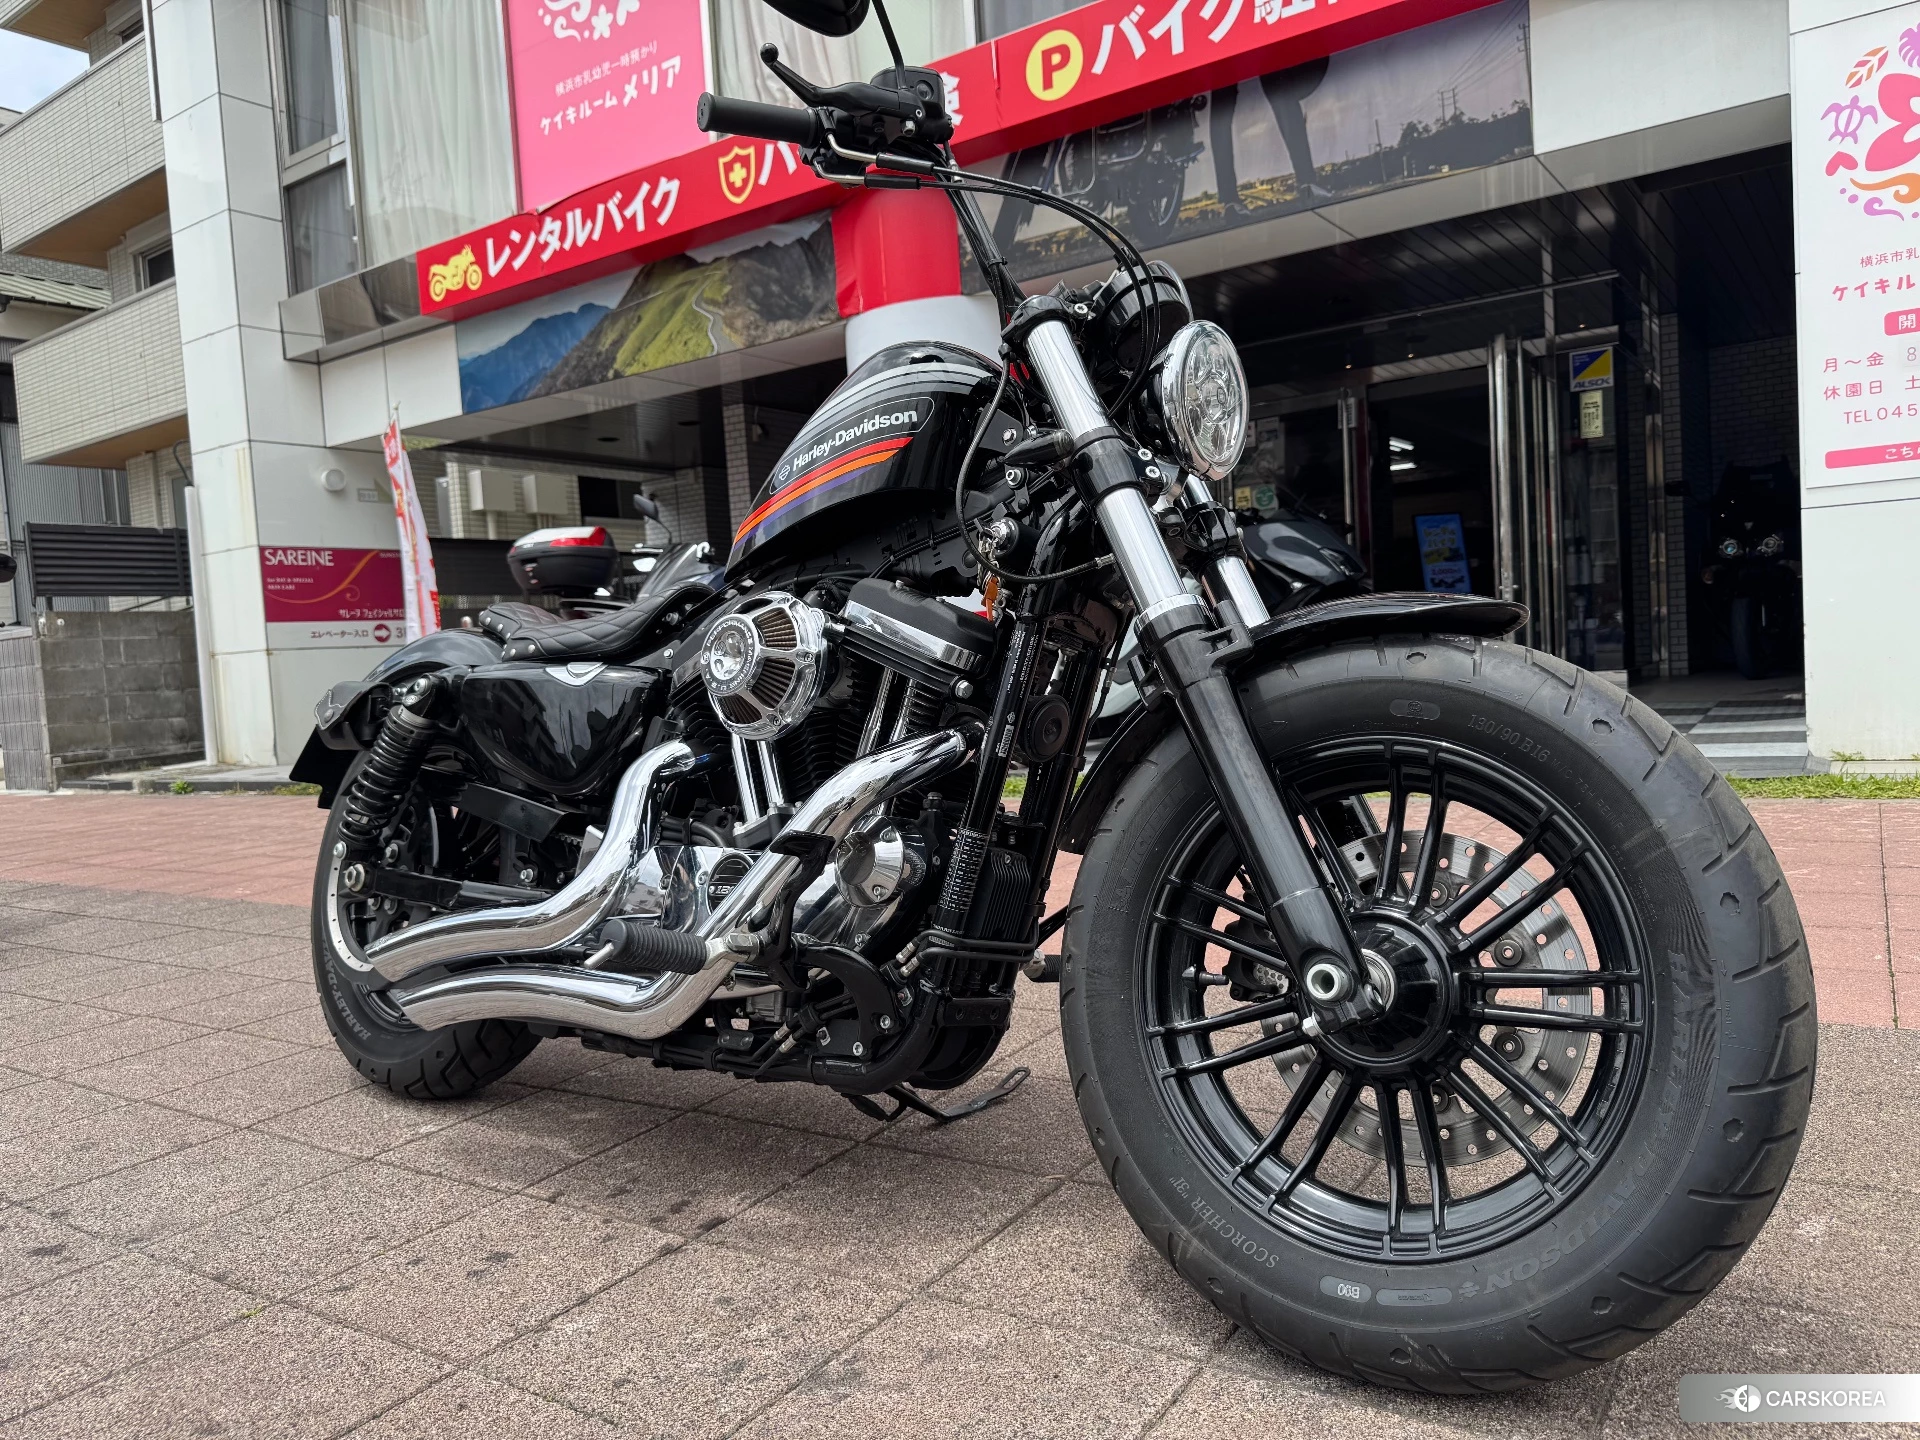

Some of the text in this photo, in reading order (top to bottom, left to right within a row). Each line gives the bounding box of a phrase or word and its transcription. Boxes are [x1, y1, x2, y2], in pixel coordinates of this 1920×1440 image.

[555, 40, 657, 97] 横浜市乳幼児一時預かり
[486, 176, 680, 278] レンタルバイク
[1860, 247, 1919, 268] 横浜市乳
[1832, 274, 1916, 301] ケイキル
[1898, 313, 1916, 330] 開
[1823, 380, 1882, 401] 休園日
[793, 410, 918, 471] Harley-Davidson
[264, 549, 335, 566] SAREINE
[310, 629, 369, 639] エレベーター入口
[1191, 1196, 1279, 1268] SCORCHER
